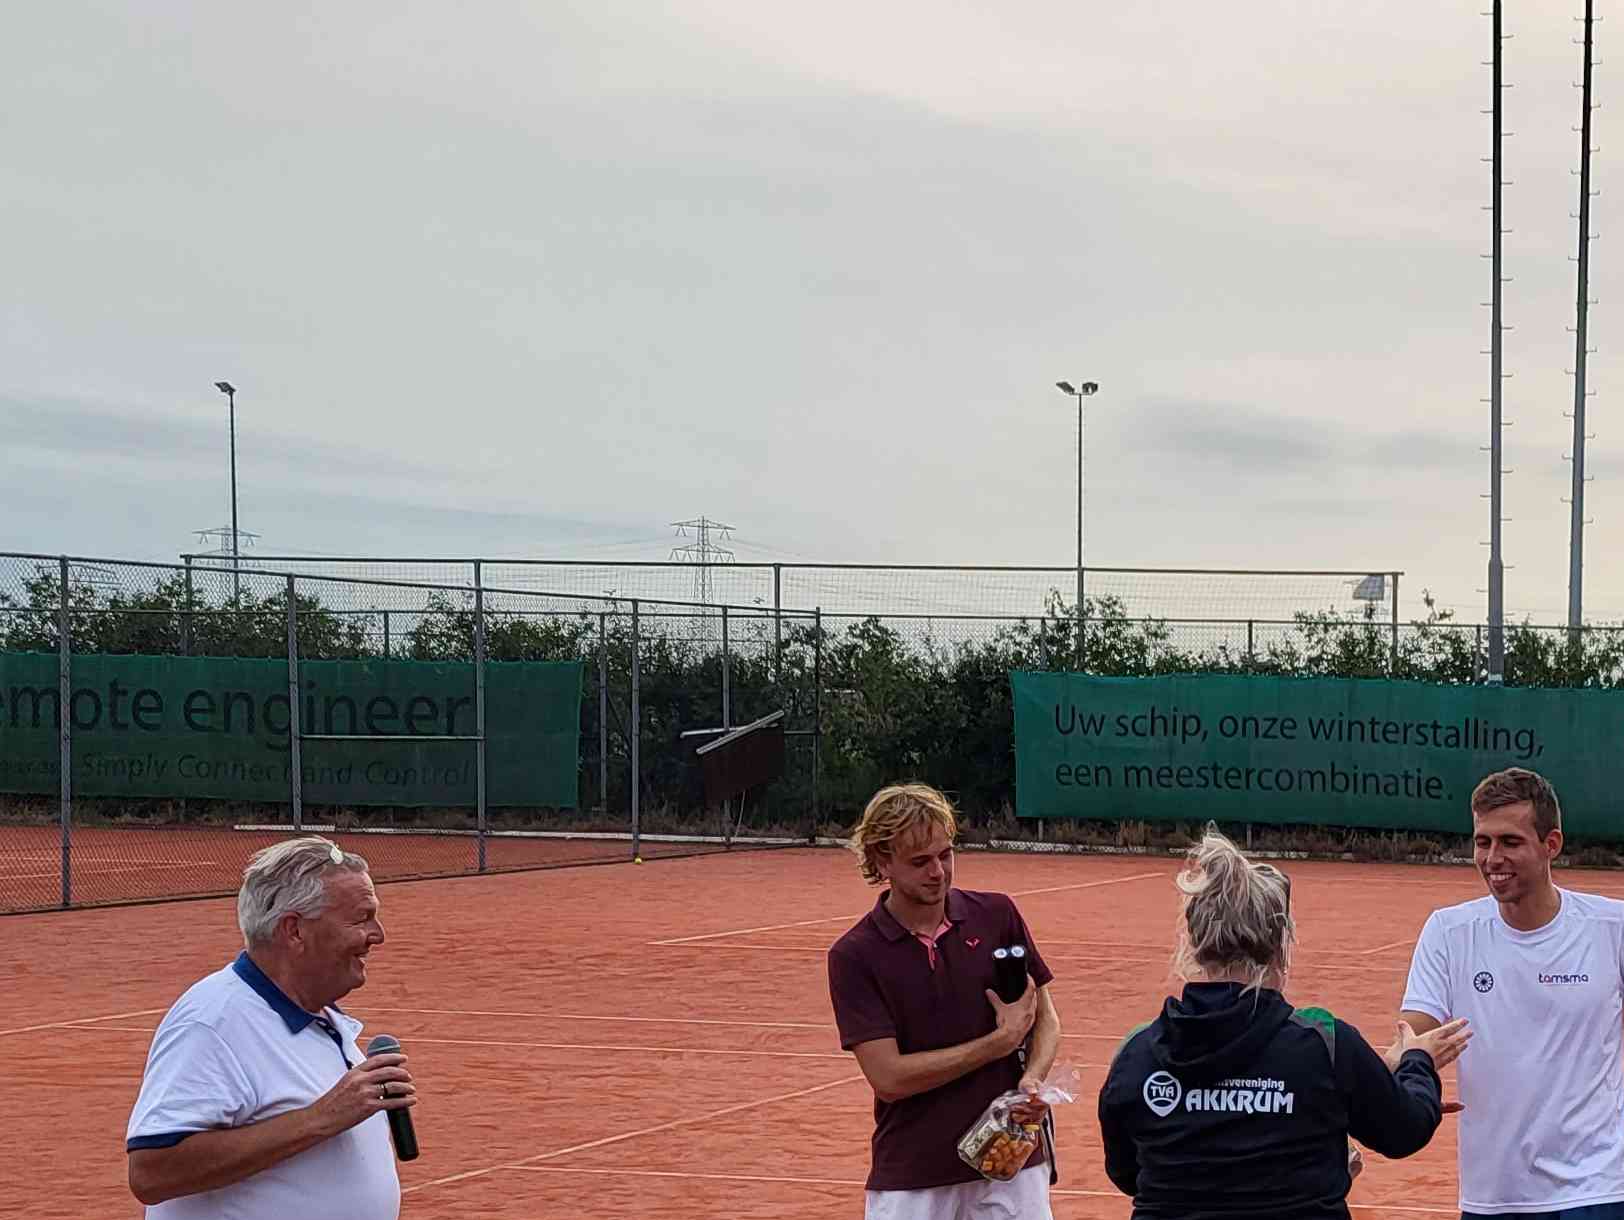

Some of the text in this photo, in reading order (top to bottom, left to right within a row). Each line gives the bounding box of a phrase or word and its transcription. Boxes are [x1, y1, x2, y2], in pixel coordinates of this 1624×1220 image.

[0, 677, 472, 750] mote engineer
[1055, 704, 1544, 758] Uw schip, onze winterstalling,
[81, 752, 166, 783] Simply
[301, 758, 352, 785] and
[366, 757, 471, 786] Control
[1055, 761, 1453, 801] een meestercombinatie.
[1538, 972, 1589, 984] tamsma
[1150, 1084, 1175, 1098] TVA
[1185, 1088, 1294, 1114] AKKRUM
